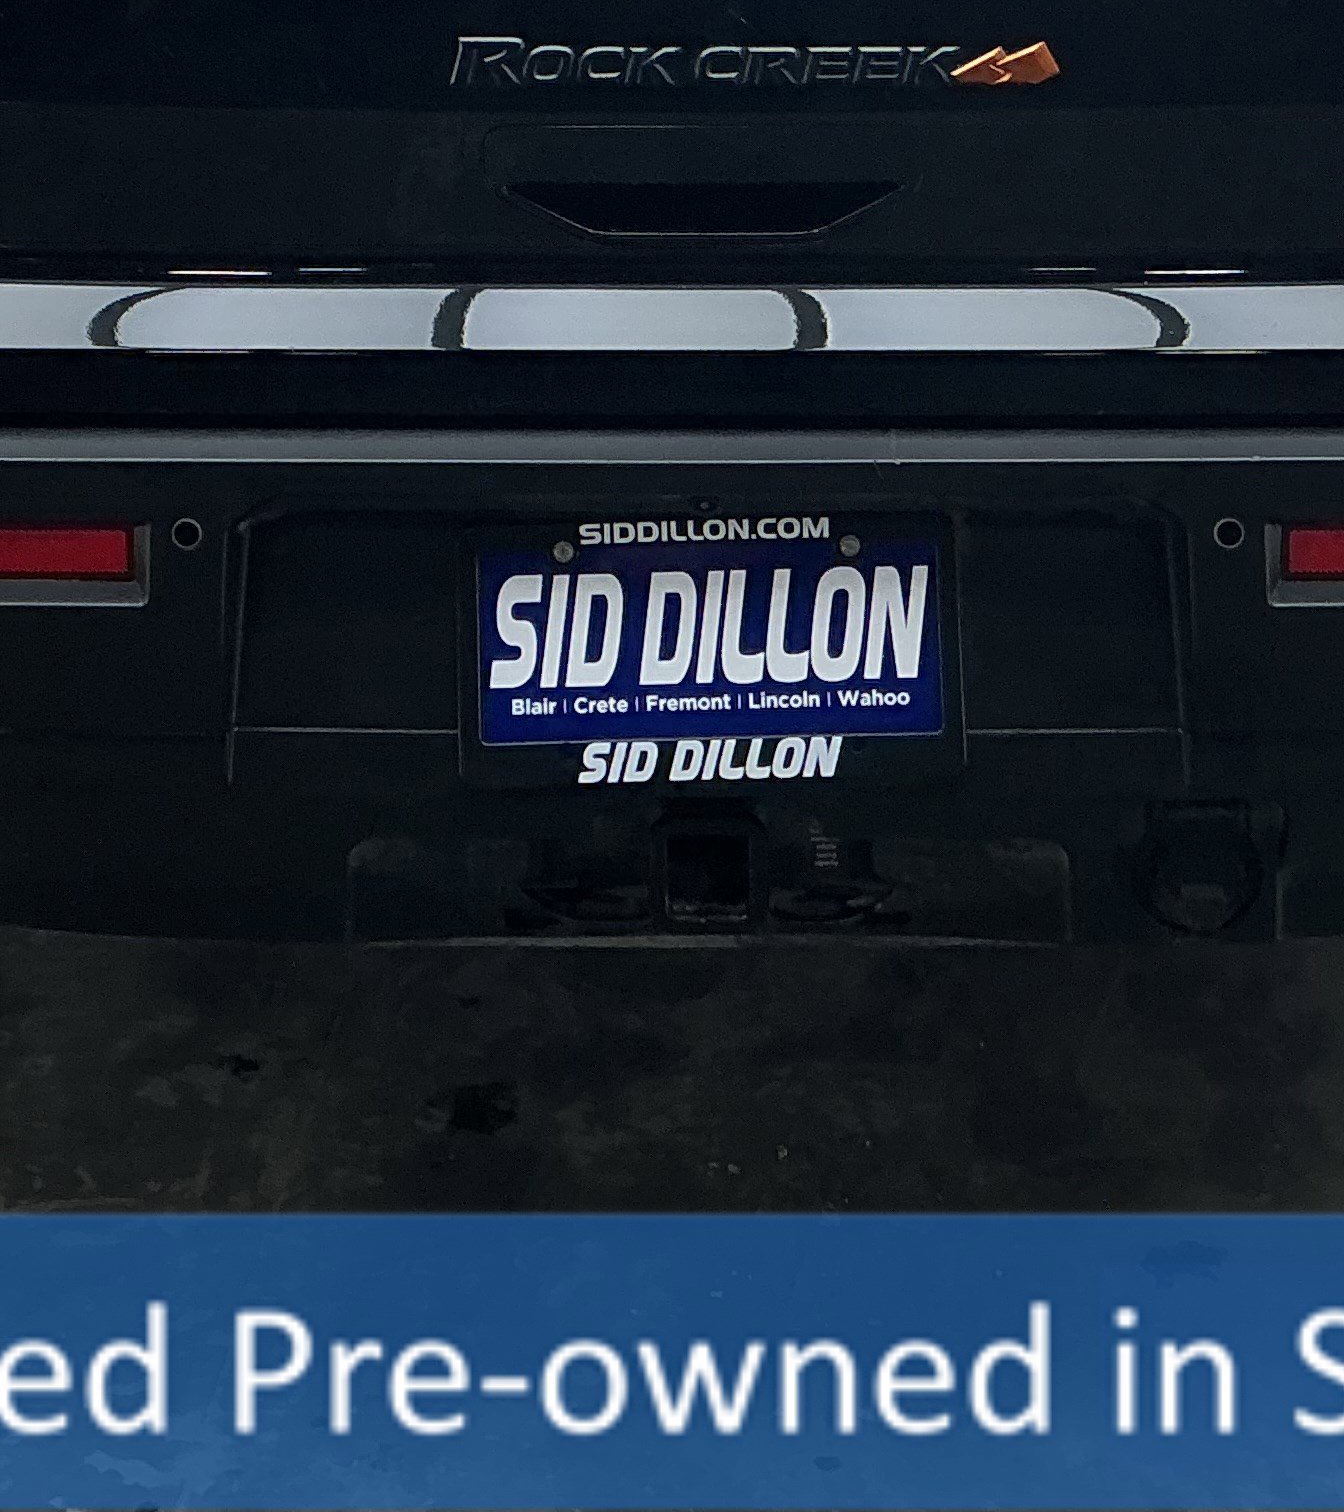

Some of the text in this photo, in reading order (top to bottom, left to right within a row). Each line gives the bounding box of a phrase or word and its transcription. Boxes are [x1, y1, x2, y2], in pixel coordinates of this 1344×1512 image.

[578, 516, 830, 545] SIDDILLON.COM
[489, 565, 928, 689] SID DILLON
[511, 689, 911, 716] Blair Crete Fremont Lincoln Wahoo
[577, 736, 843, 783] SID DILLON
